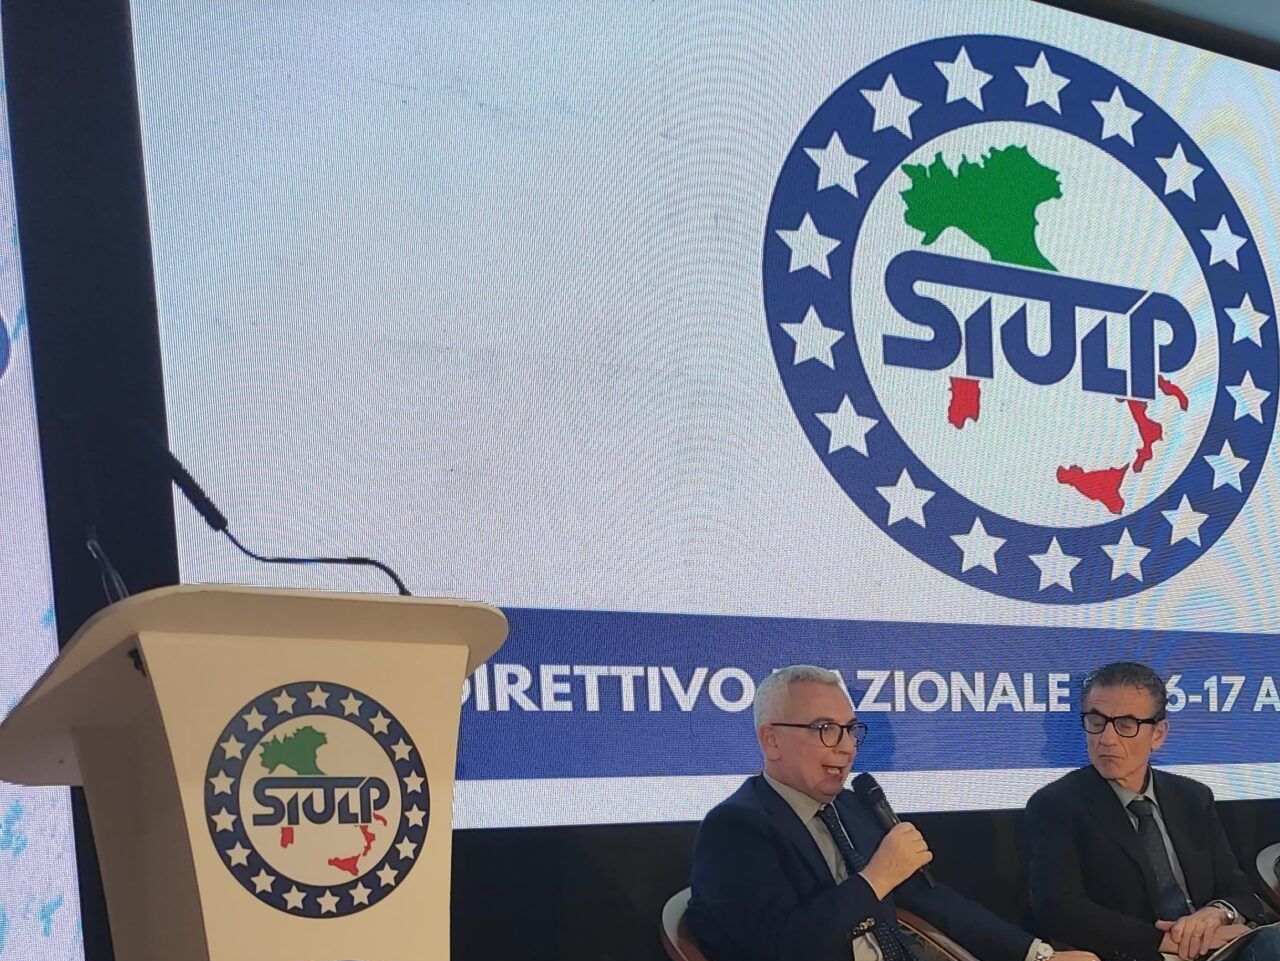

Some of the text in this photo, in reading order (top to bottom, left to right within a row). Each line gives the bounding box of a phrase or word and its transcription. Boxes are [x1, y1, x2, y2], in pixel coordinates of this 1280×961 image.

[883, 250, 1197, 400] SIULP
[461, 663, 756, 712] IRETTIVO
[772, 668, 1071, 712] ZIONALE
[1165, 674, 1247, 712] 6-17
[252, 776, 391, 826] SIULP
